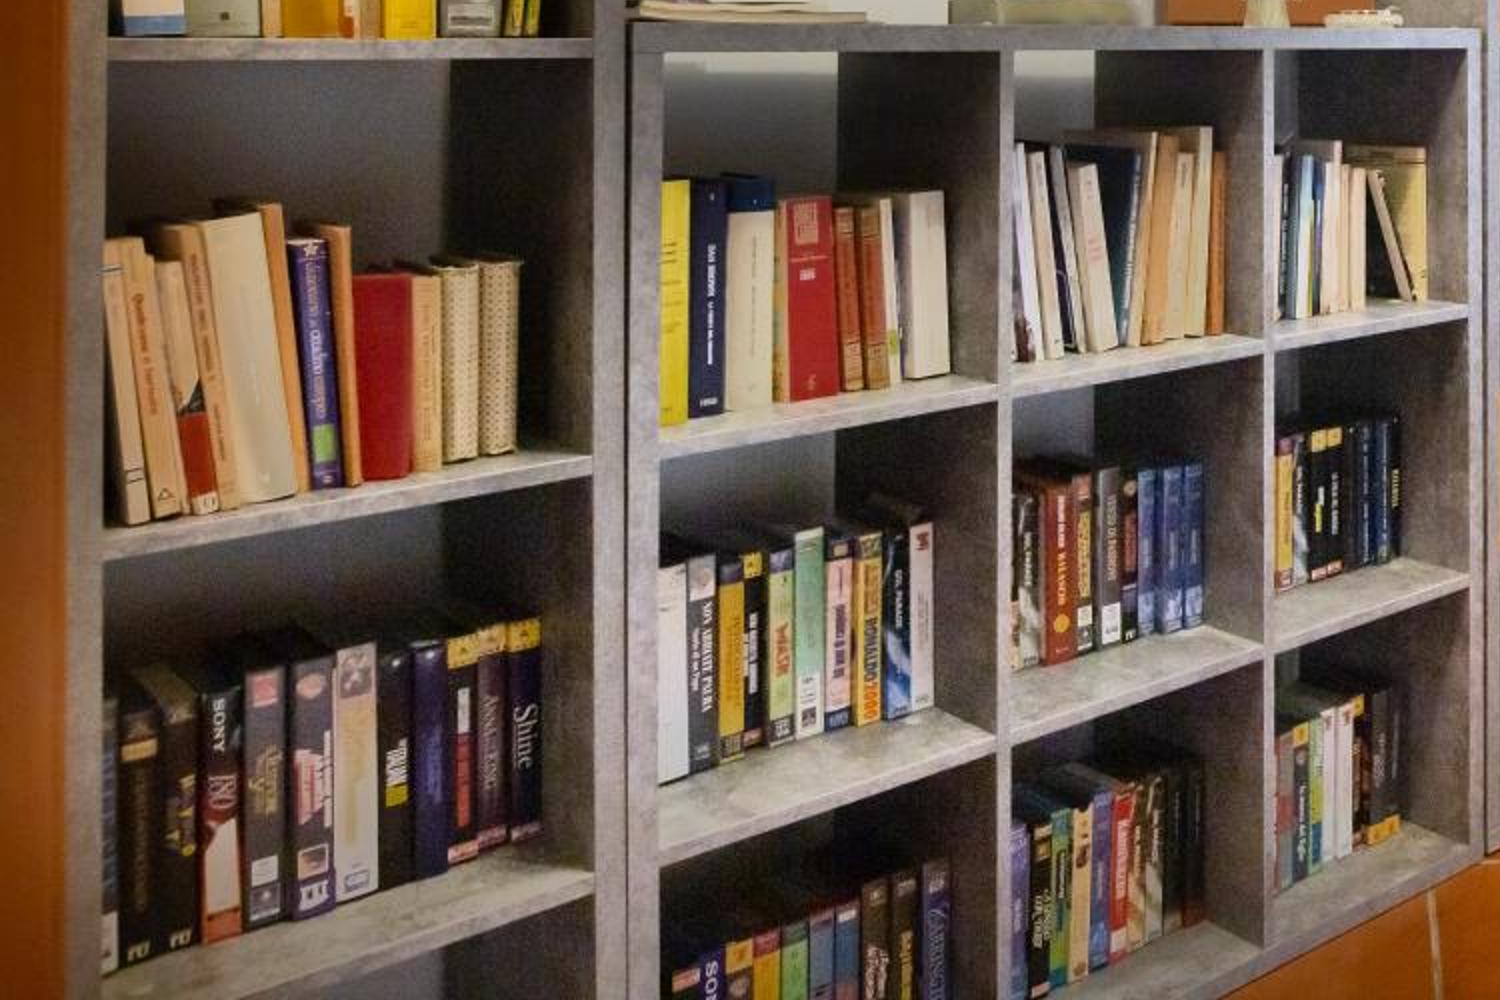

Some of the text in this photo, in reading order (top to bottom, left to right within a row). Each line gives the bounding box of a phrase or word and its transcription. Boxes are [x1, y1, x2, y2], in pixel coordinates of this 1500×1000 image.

[702, 600, 714, 625] NON
[702, 675, 714, 713] PAURA
[864, 617, 879, 720] RONALDO 2000
[212, 697, 225, 752] SONY
[513, 702, 539, 771] Shine
